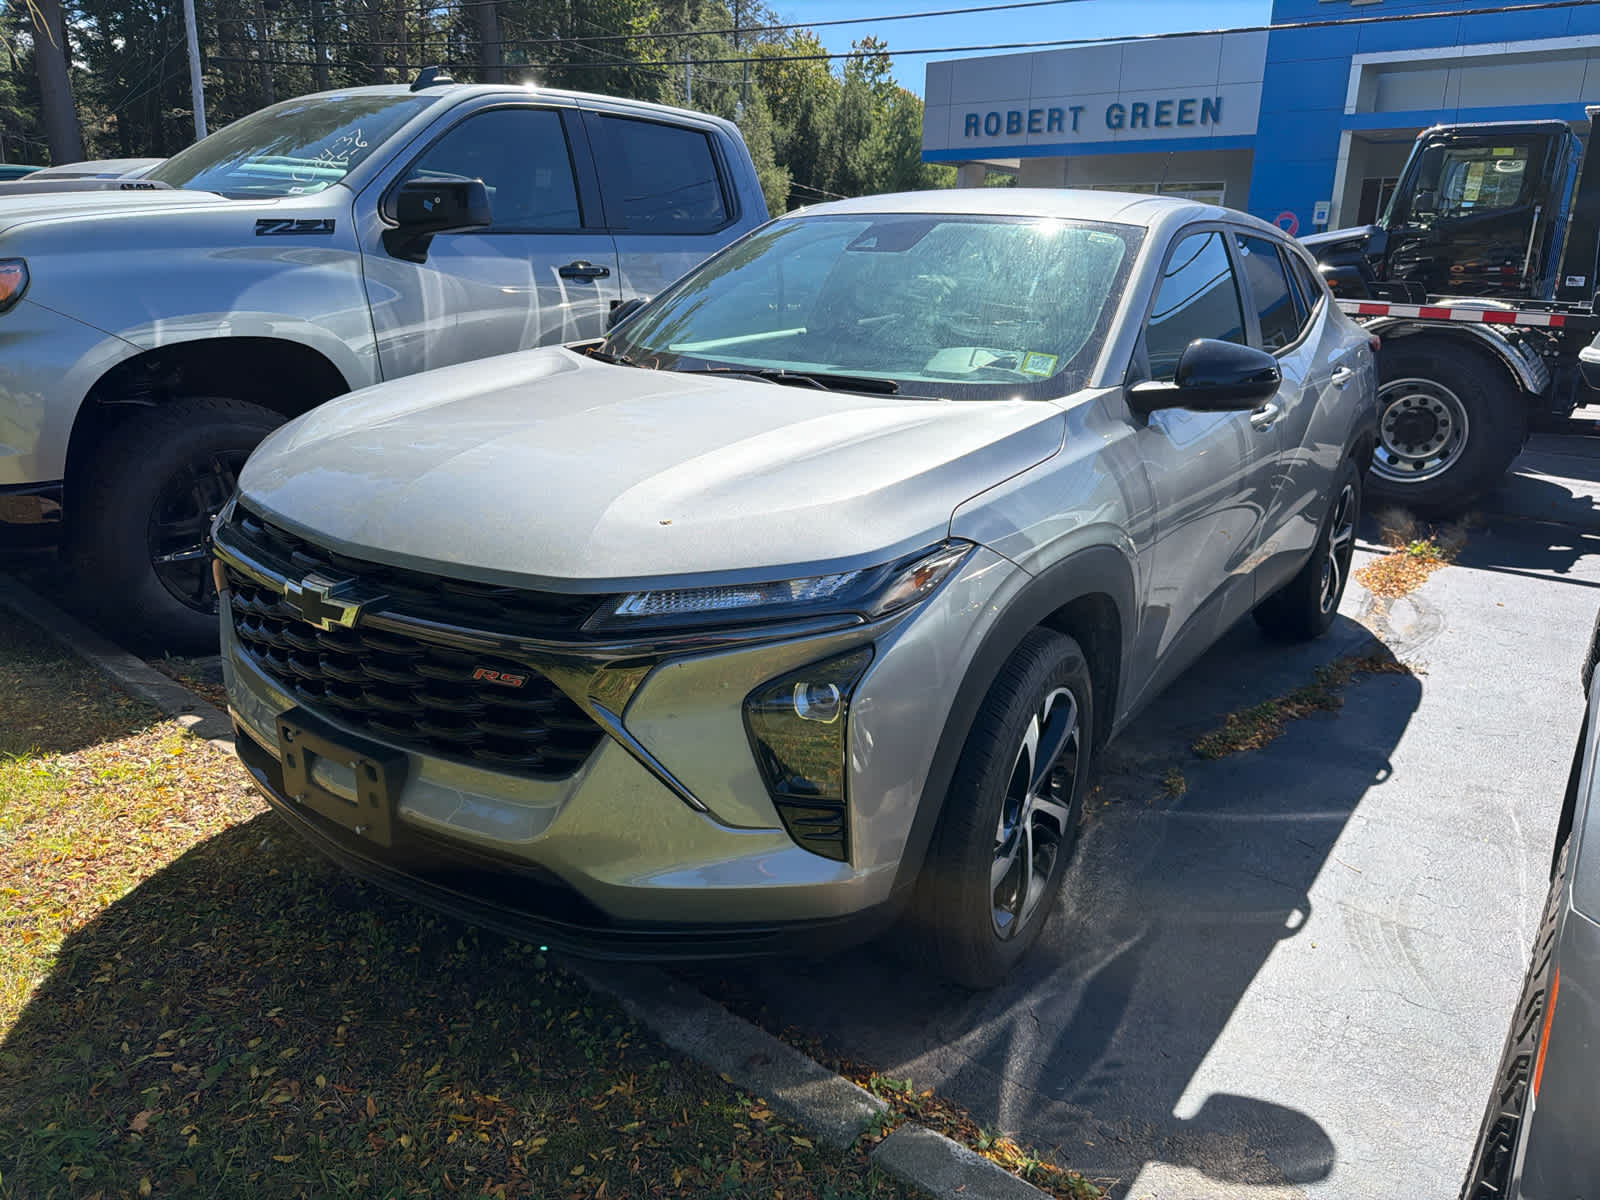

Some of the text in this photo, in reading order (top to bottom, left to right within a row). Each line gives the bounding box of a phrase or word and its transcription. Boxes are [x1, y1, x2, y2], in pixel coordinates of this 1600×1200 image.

[964, 97, 1222, 137] ROBERT GREEN
[255, 218, 336, 236] Z71
[472, 668, 525, 687] RS
